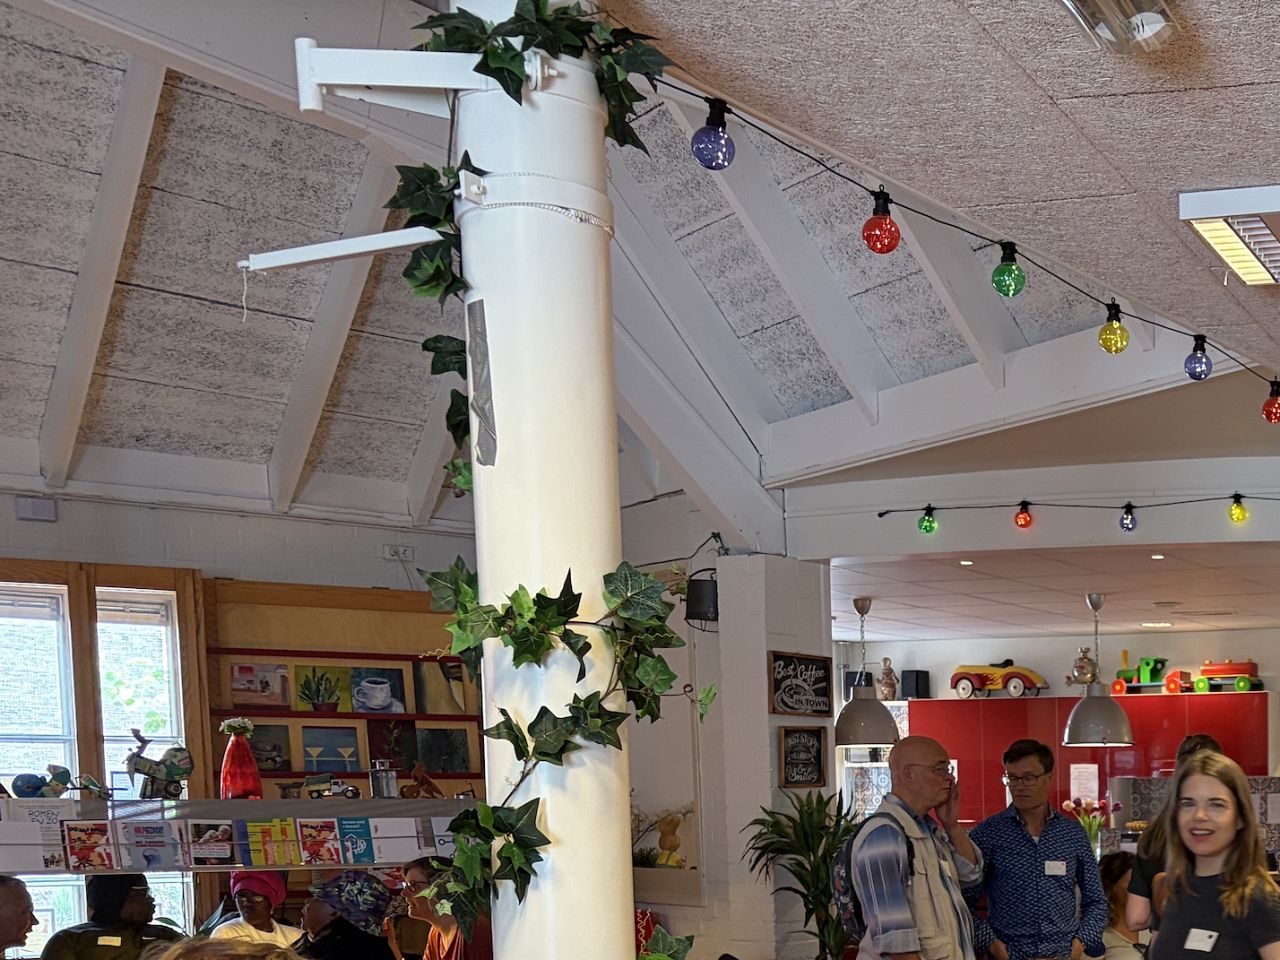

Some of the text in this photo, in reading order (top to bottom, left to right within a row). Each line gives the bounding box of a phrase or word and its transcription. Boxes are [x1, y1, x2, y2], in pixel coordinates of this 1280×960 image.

[773, 660, 826, 682] Best Coffee
[805, 698, 828, 708] TOWN
